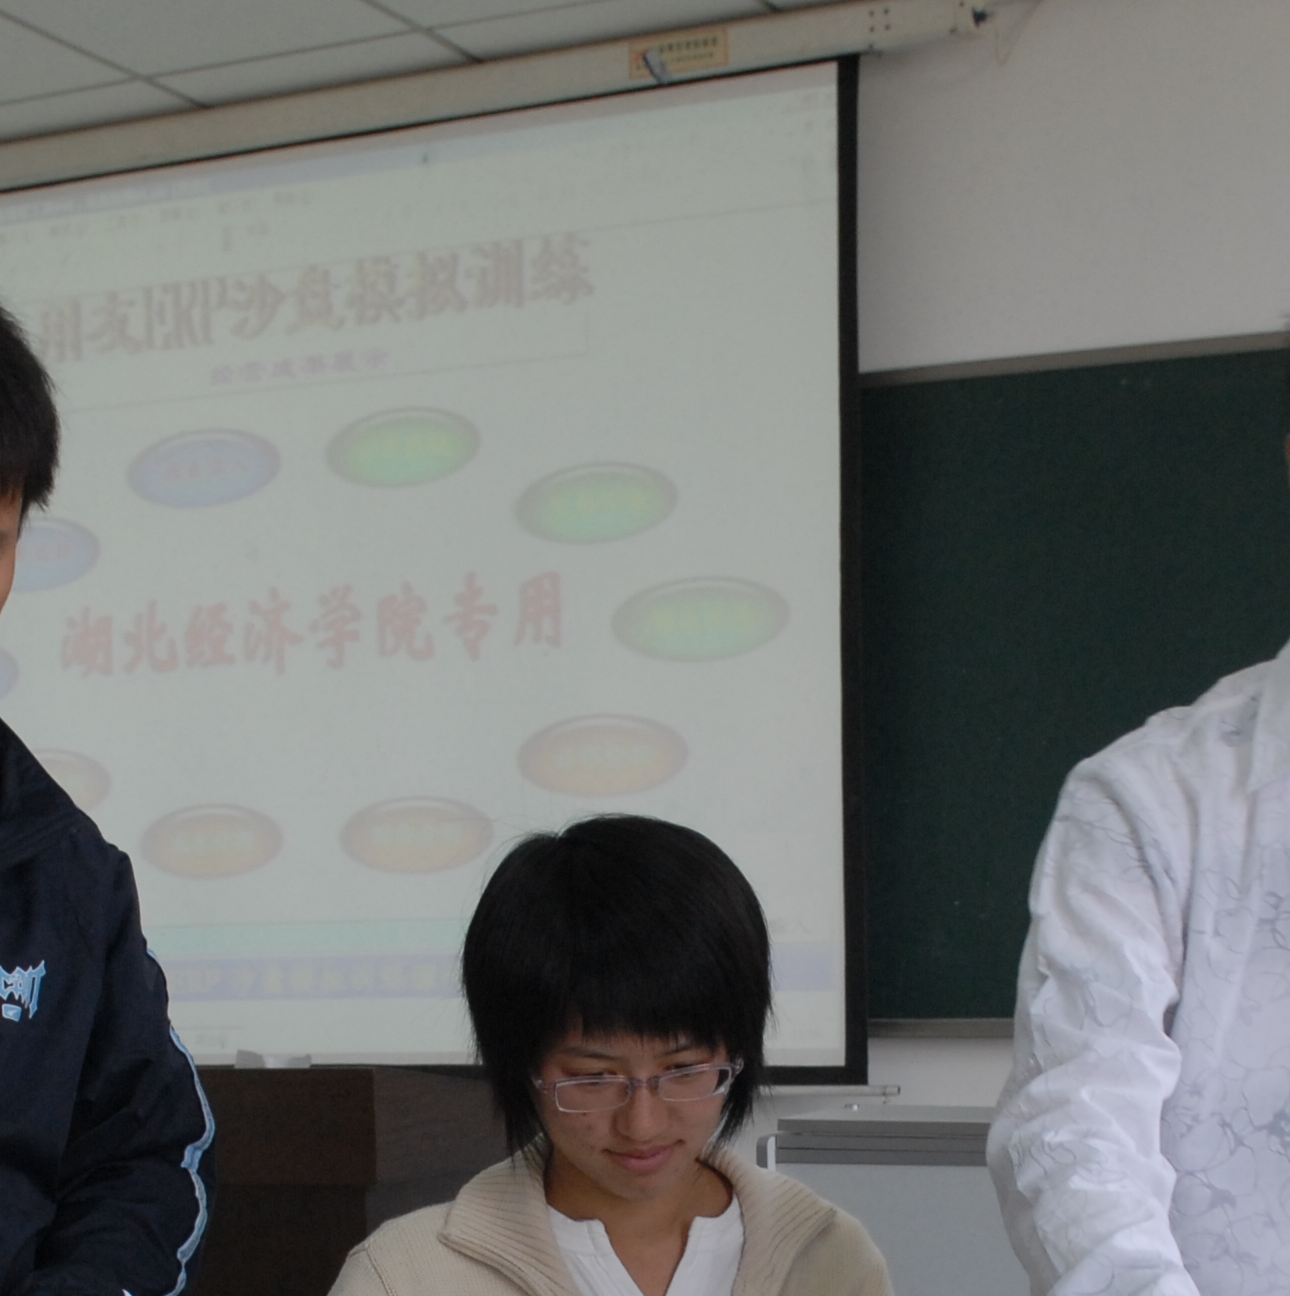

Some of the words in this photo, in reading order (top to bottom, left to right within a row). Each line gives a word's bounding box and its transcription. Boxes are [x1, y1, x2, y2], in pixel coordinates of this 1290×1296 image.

[59, 570, 562, 678] 湖北经济学院专用
